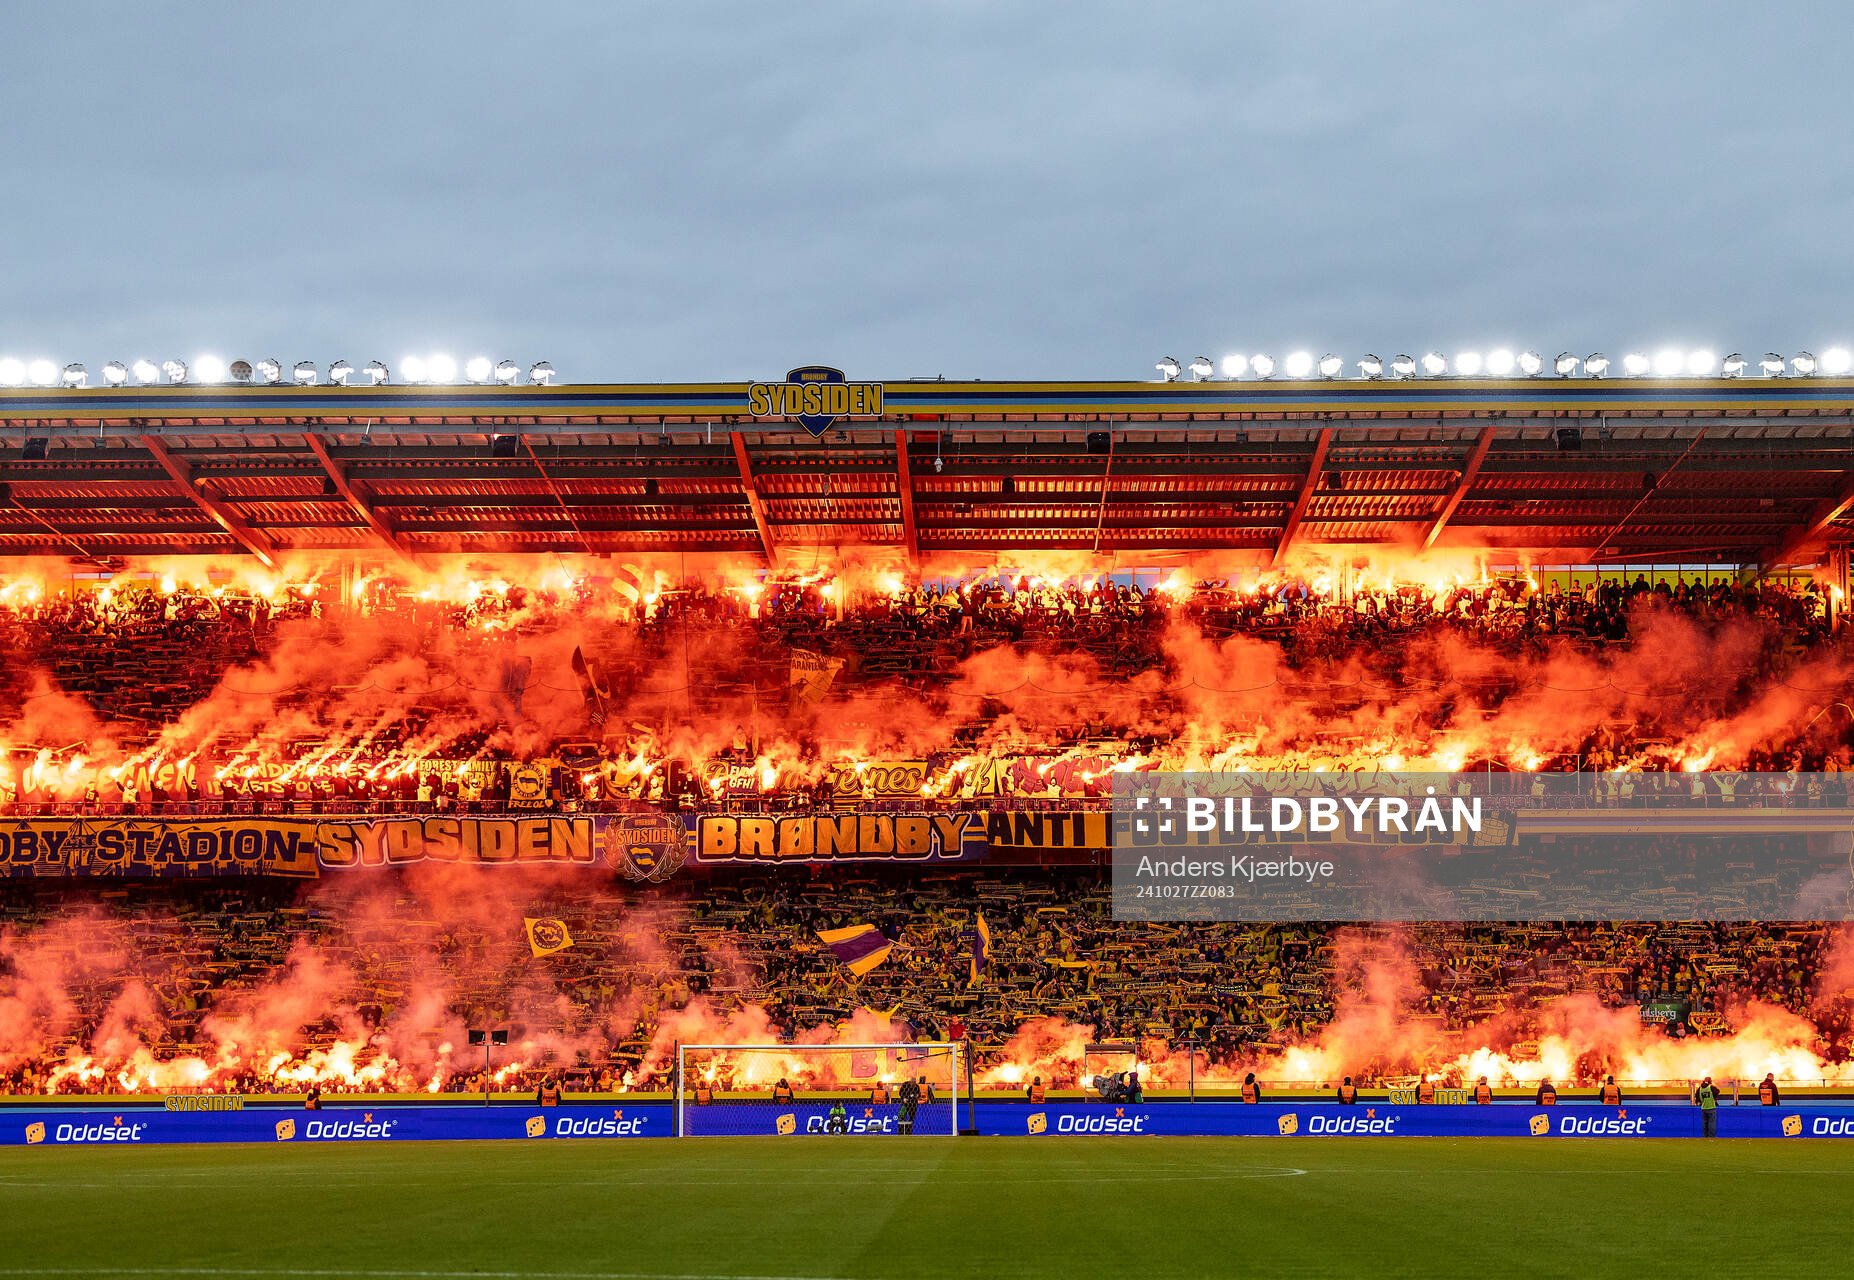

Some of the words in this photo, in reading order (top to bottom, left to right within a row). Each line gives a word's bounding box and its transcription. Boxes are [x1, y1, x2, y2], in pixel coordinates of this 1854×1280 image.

[749, 383, 883, 416] SYDSIDEN
[617, 829, 676, 845] SYDSIDEN
[699, 815, 969, 859] BRØNDBY
[987, 811, 1085, 847] ANTI
[97, 829, 300, 863] STADION
[318, 818, 593, 864] SYDSIDEN
[165, 1096, 244, 1111] SYDSIDEN
[1389, 1090, 1468, 1105] SYIDEN
[56, 1123, 142, 1141] Oddset
[306, 1120, 391, 1139] Oddset
[557, 1117, 642, 1135] Oddset
[1058, 1114, 1144, 1133] Oddset
[1309, 1115, 1395, 1133] Oddset
[1560, 1116, 1646, 1135] Oddset
